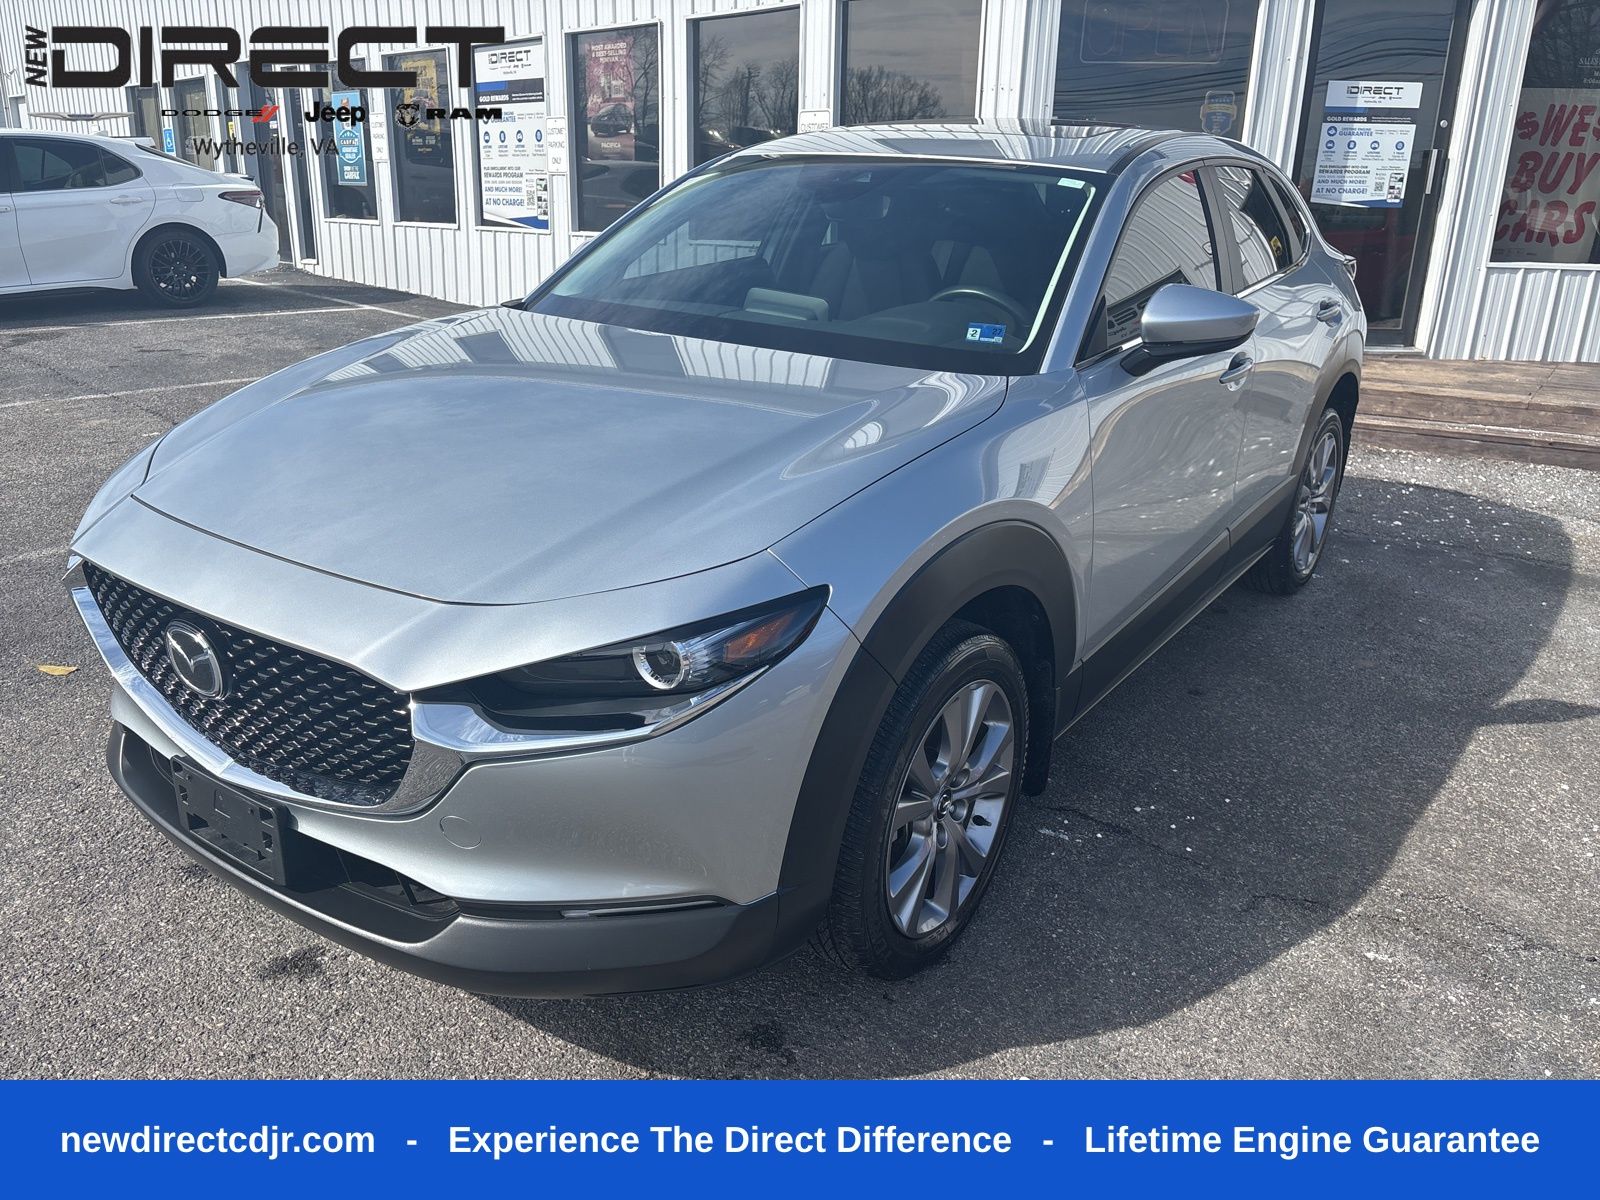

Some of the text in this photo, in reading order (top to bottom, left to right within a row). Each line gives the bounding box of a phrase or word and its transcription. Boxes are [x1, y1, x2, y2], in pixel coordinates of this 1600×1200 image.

[490, 49, 531, 64] DIRECT
[1350, 86, 1404, 96] DIRECT
[1510, 151, 1600, 195] BUY
[485, 198, 525, 207] AT NO CHARGE!
[1494, 200, 1597, 247] CARS
[971, 329, 978, 338] 2
